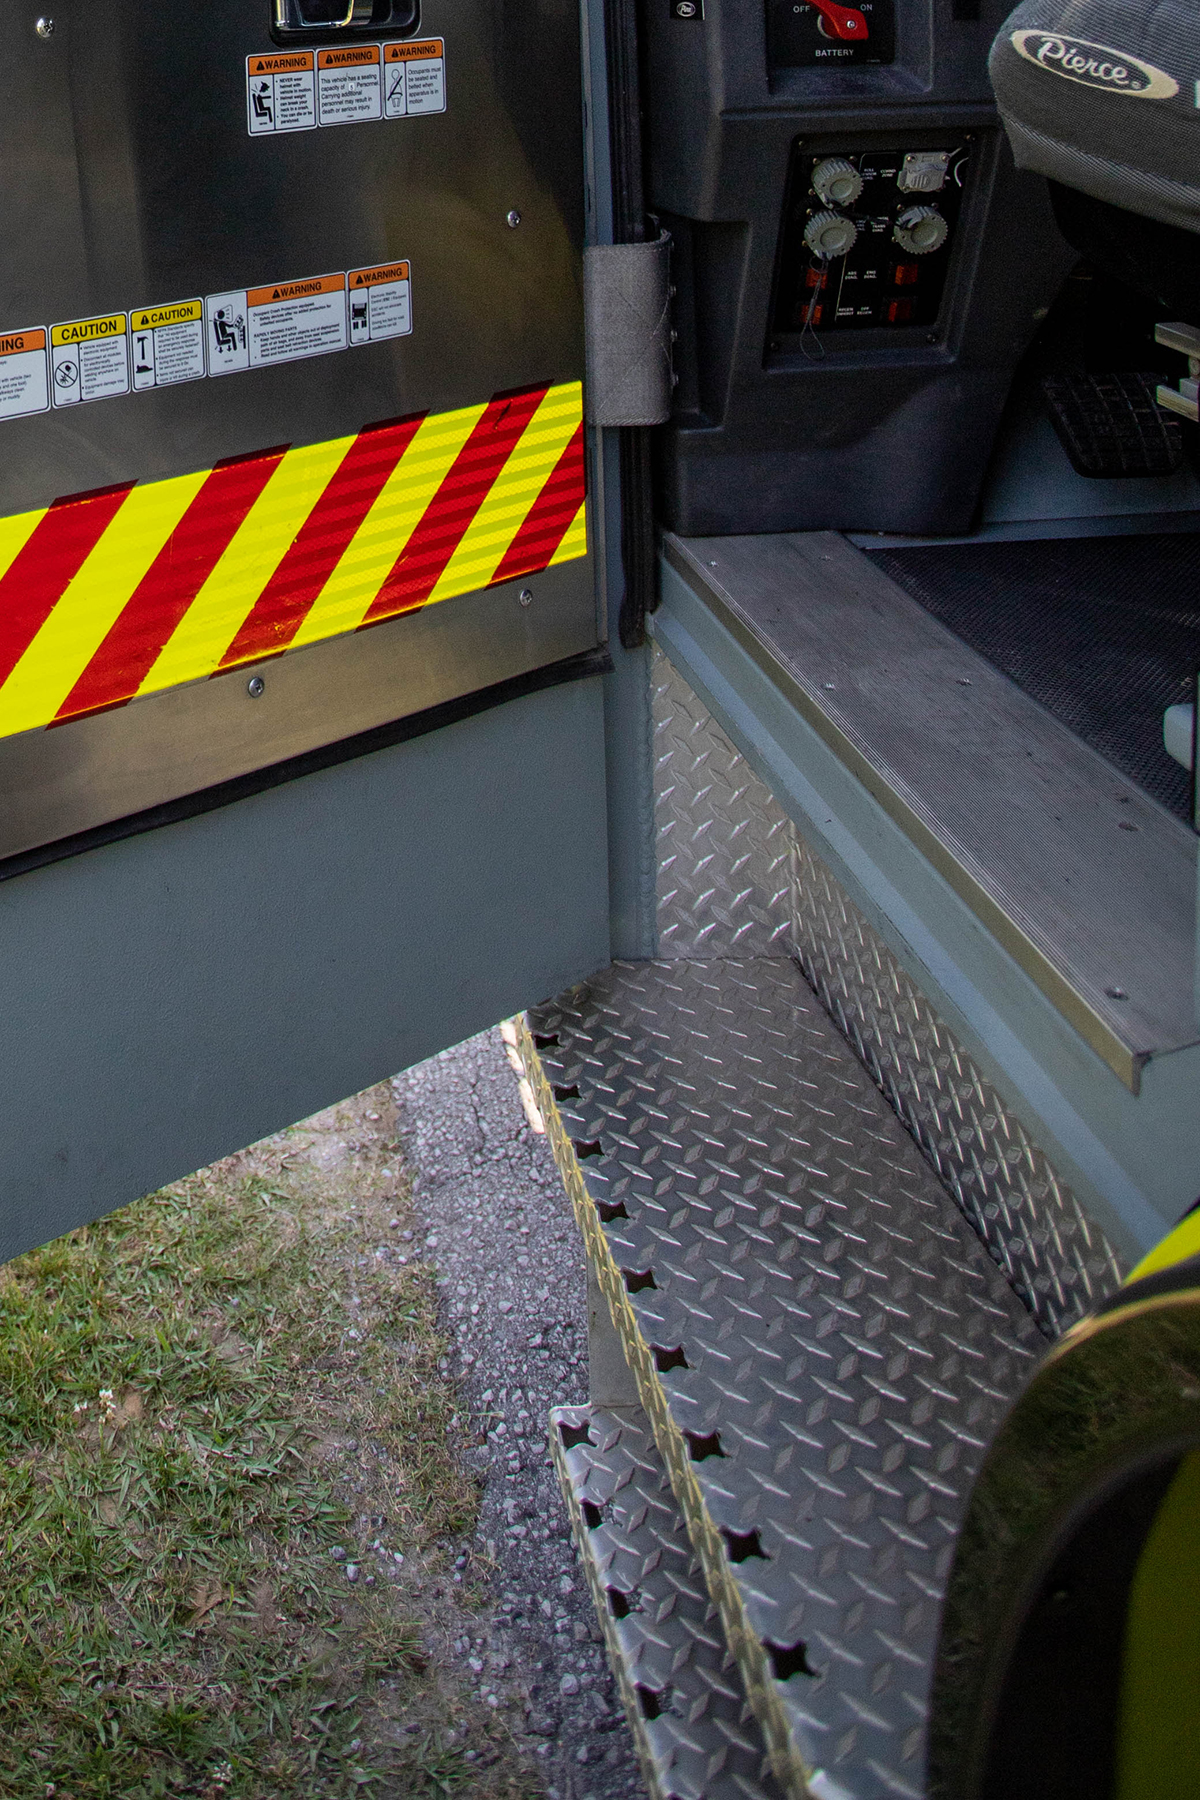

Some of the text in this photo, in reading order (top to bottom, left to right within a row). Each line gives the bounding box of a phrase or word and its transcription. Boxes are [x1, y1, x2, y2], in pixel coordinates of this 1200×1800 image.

[333, 51, 372, 63] WARNING
[399, 45, 436, 56] WARNING
[265, 57, 306, 69] WARNING
[1038, 37, 1128, 84] Pierce
[363, 268, 402, 282] WARNING
[281, 282, 322, 297] WARNING
[151, 307, 193, 323] CAUTION
[62, 320, 117, 340] CAUTION
